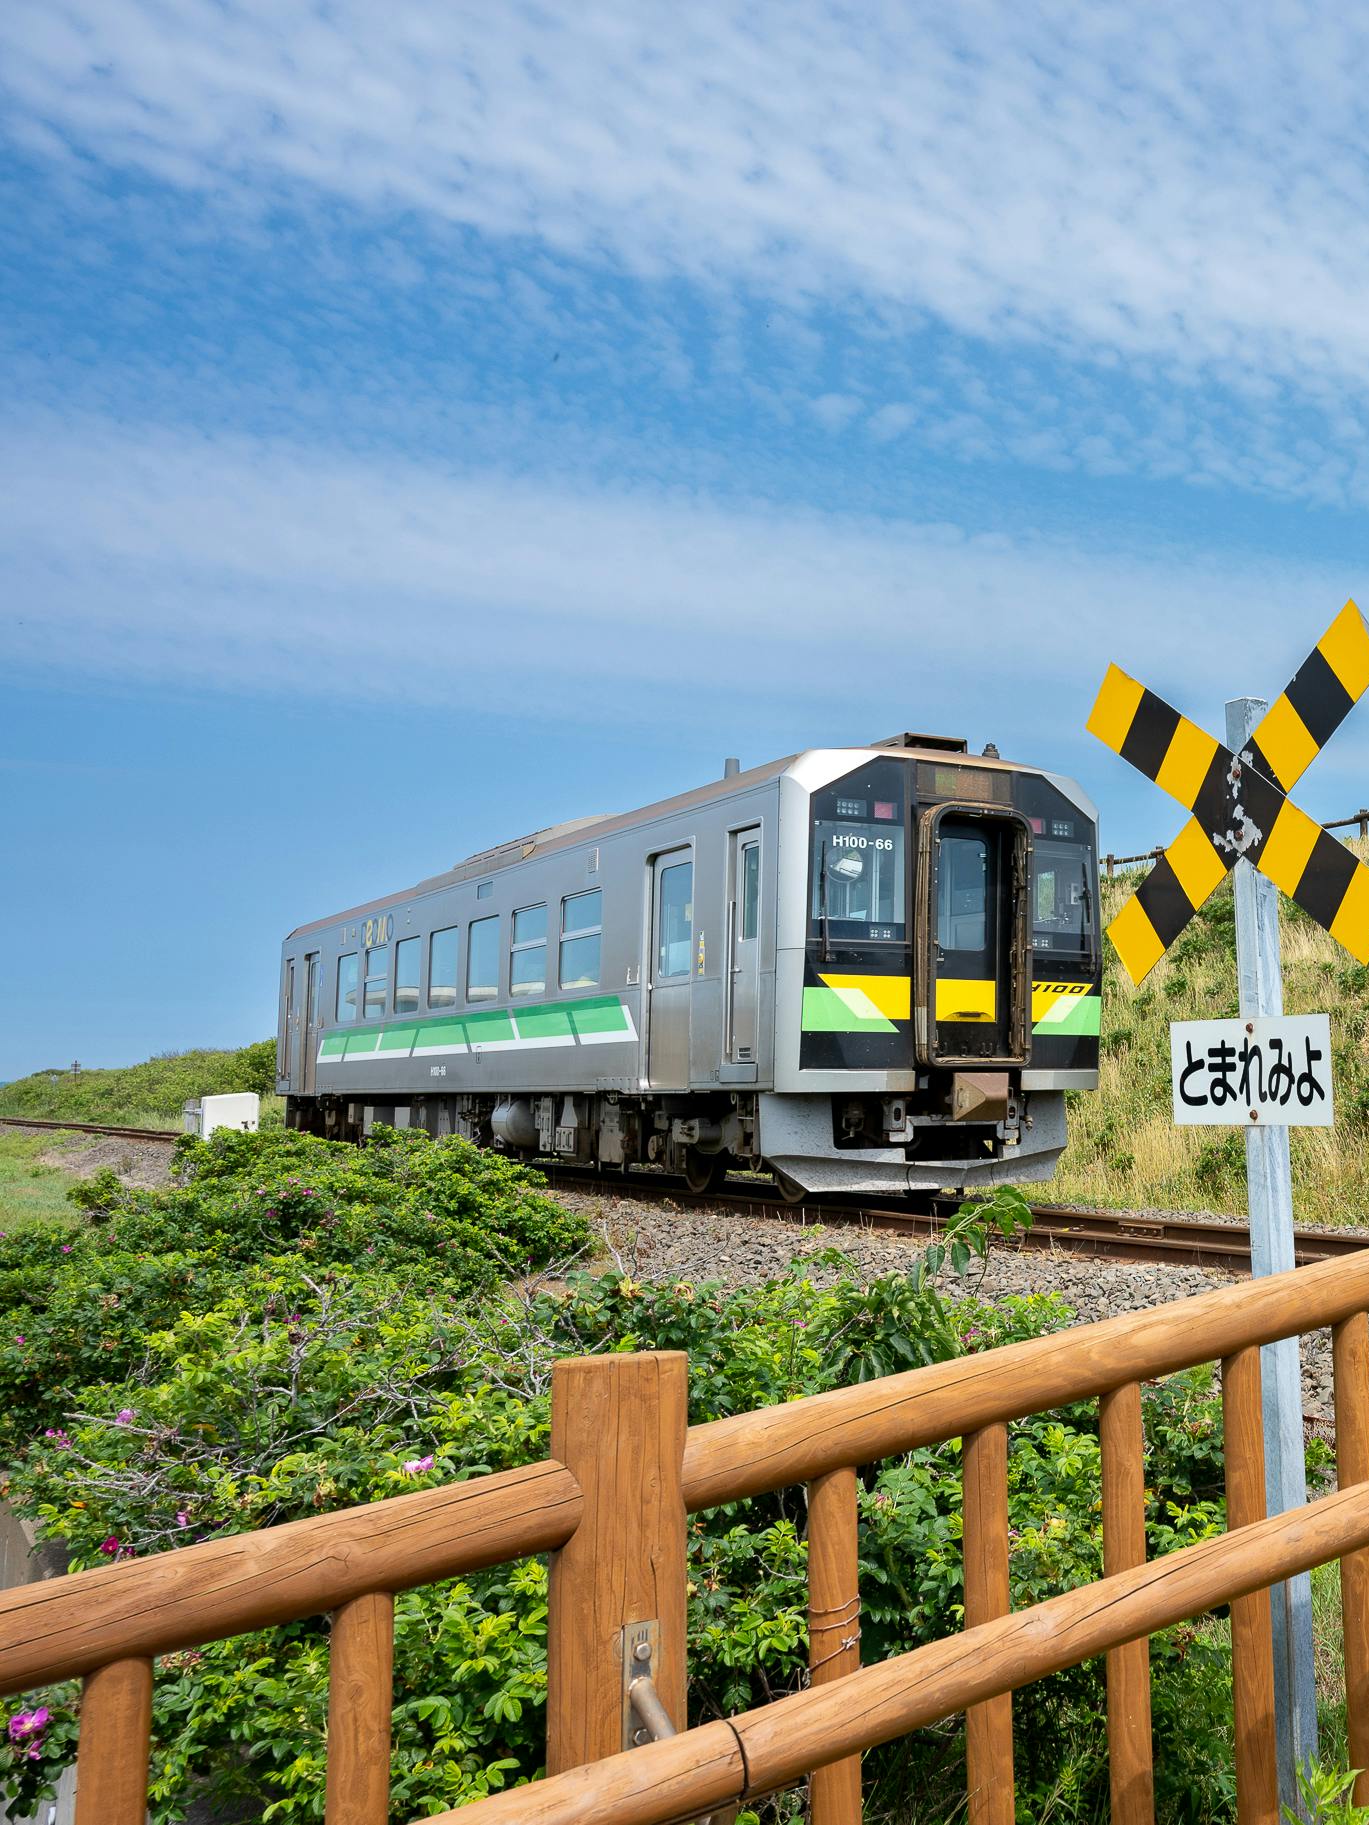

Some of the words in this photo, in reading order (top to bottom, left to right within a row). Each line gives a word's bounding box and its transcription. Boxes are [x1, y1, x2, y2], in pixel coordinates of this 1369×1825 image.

[832, 834, 893, 851] H100-66
[1180, 1036, 1324, 1106] とまれみよ
